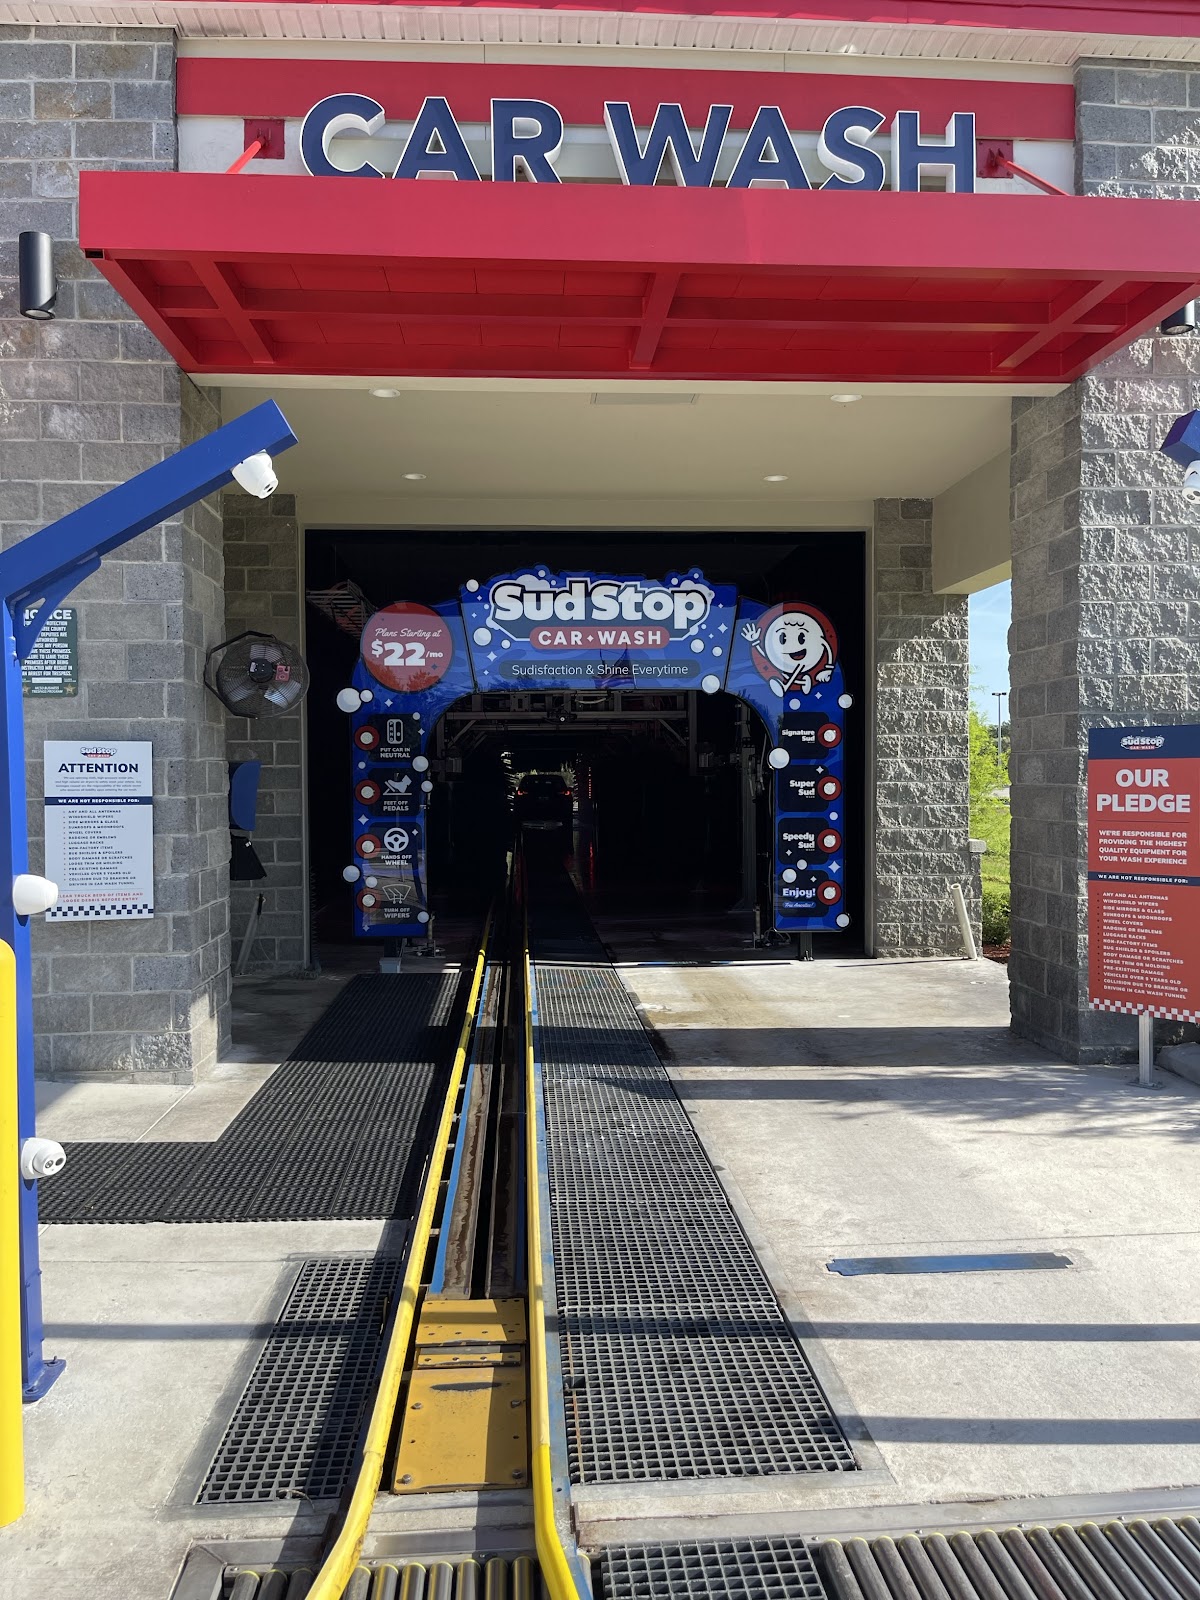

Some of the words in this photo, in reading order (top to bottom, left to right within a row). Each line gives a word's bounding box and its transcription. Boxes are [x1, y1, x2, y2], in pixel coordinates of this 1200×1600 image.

[300, 92, 564, 183] CAR
[603, 101, 976, 194] WASH
[375, 628, 398, 637] Plans
[399, 628, 431, 640] Starting
[432, 629, 442, 637] at
[538, 630, 583, 646] CAR
[598, 630, 661, 645] WASH
[512, 664, 583, 676] Sudisfaction
[586, 665, 595, 675] &
[597, 665, 629, 675] Shine
[632, 665, 688, 678] Everytime
[781, 729, 815, 737] Signature
[58, 763, 138, 773] ATTENTION
[1115, 769, 1169, 787] OUR
[789, 780, 815, 789] Super
[798, 788, 815, 796] Sud
[1096, 794, 1191, 813] PLEDGE
[782, 832, 815, 842] Speedy
[1122, 830, 1170, 838] RESPONSIBLE
[798, 841, 815, 849] Sud
[1099, 847, 1128, 855] QUALITY
[1130, 848, 1170, 856] EQUIPMENT
[1144, 857, 1187, 865] EXPERIENCE
[782, 888, 816, 899] Enjoy!
[1104, 965, 1139, 973] PRE-EXISTING
[1145, 962, 1170, 970] MOLDING
